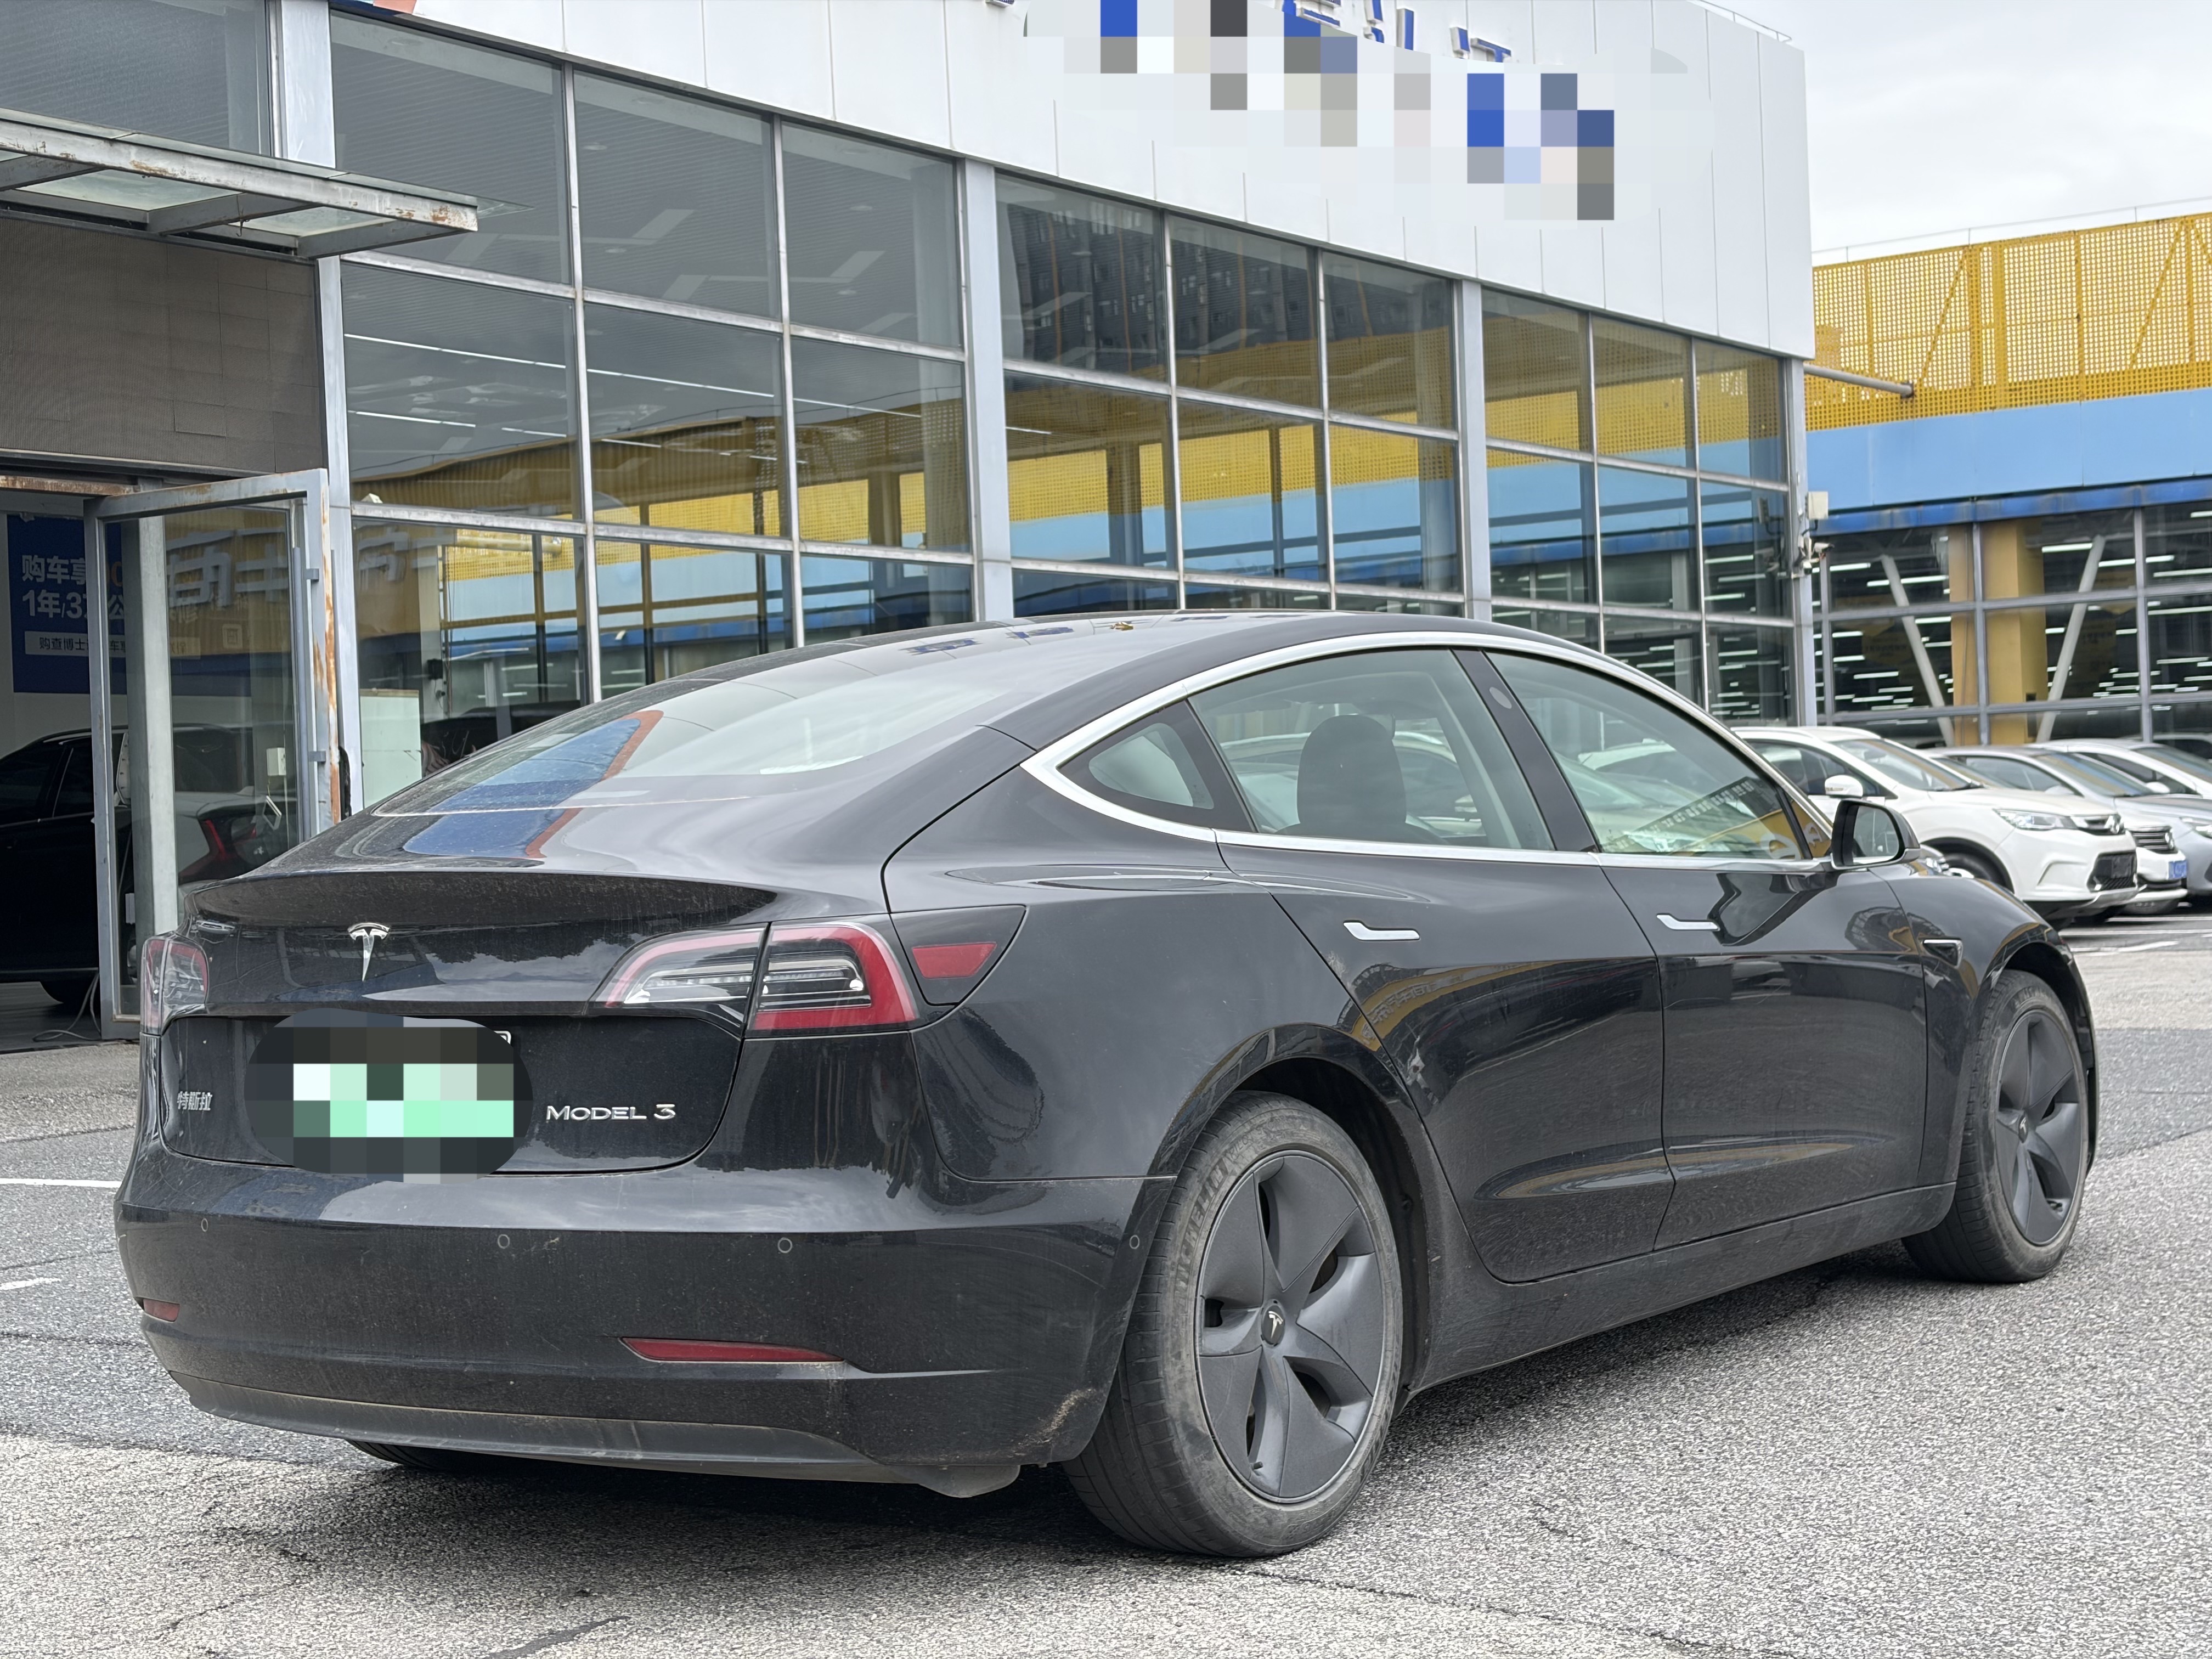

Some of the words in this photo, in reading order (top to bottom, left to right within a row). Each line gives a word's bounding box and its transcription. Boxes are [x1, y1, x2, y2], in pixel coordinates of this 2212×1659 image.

[177, 1091, 213, 1111] 特斯拉
[546, 1105, 647, 1121] MODEL
[654, 1104, 676, 1120] 3
